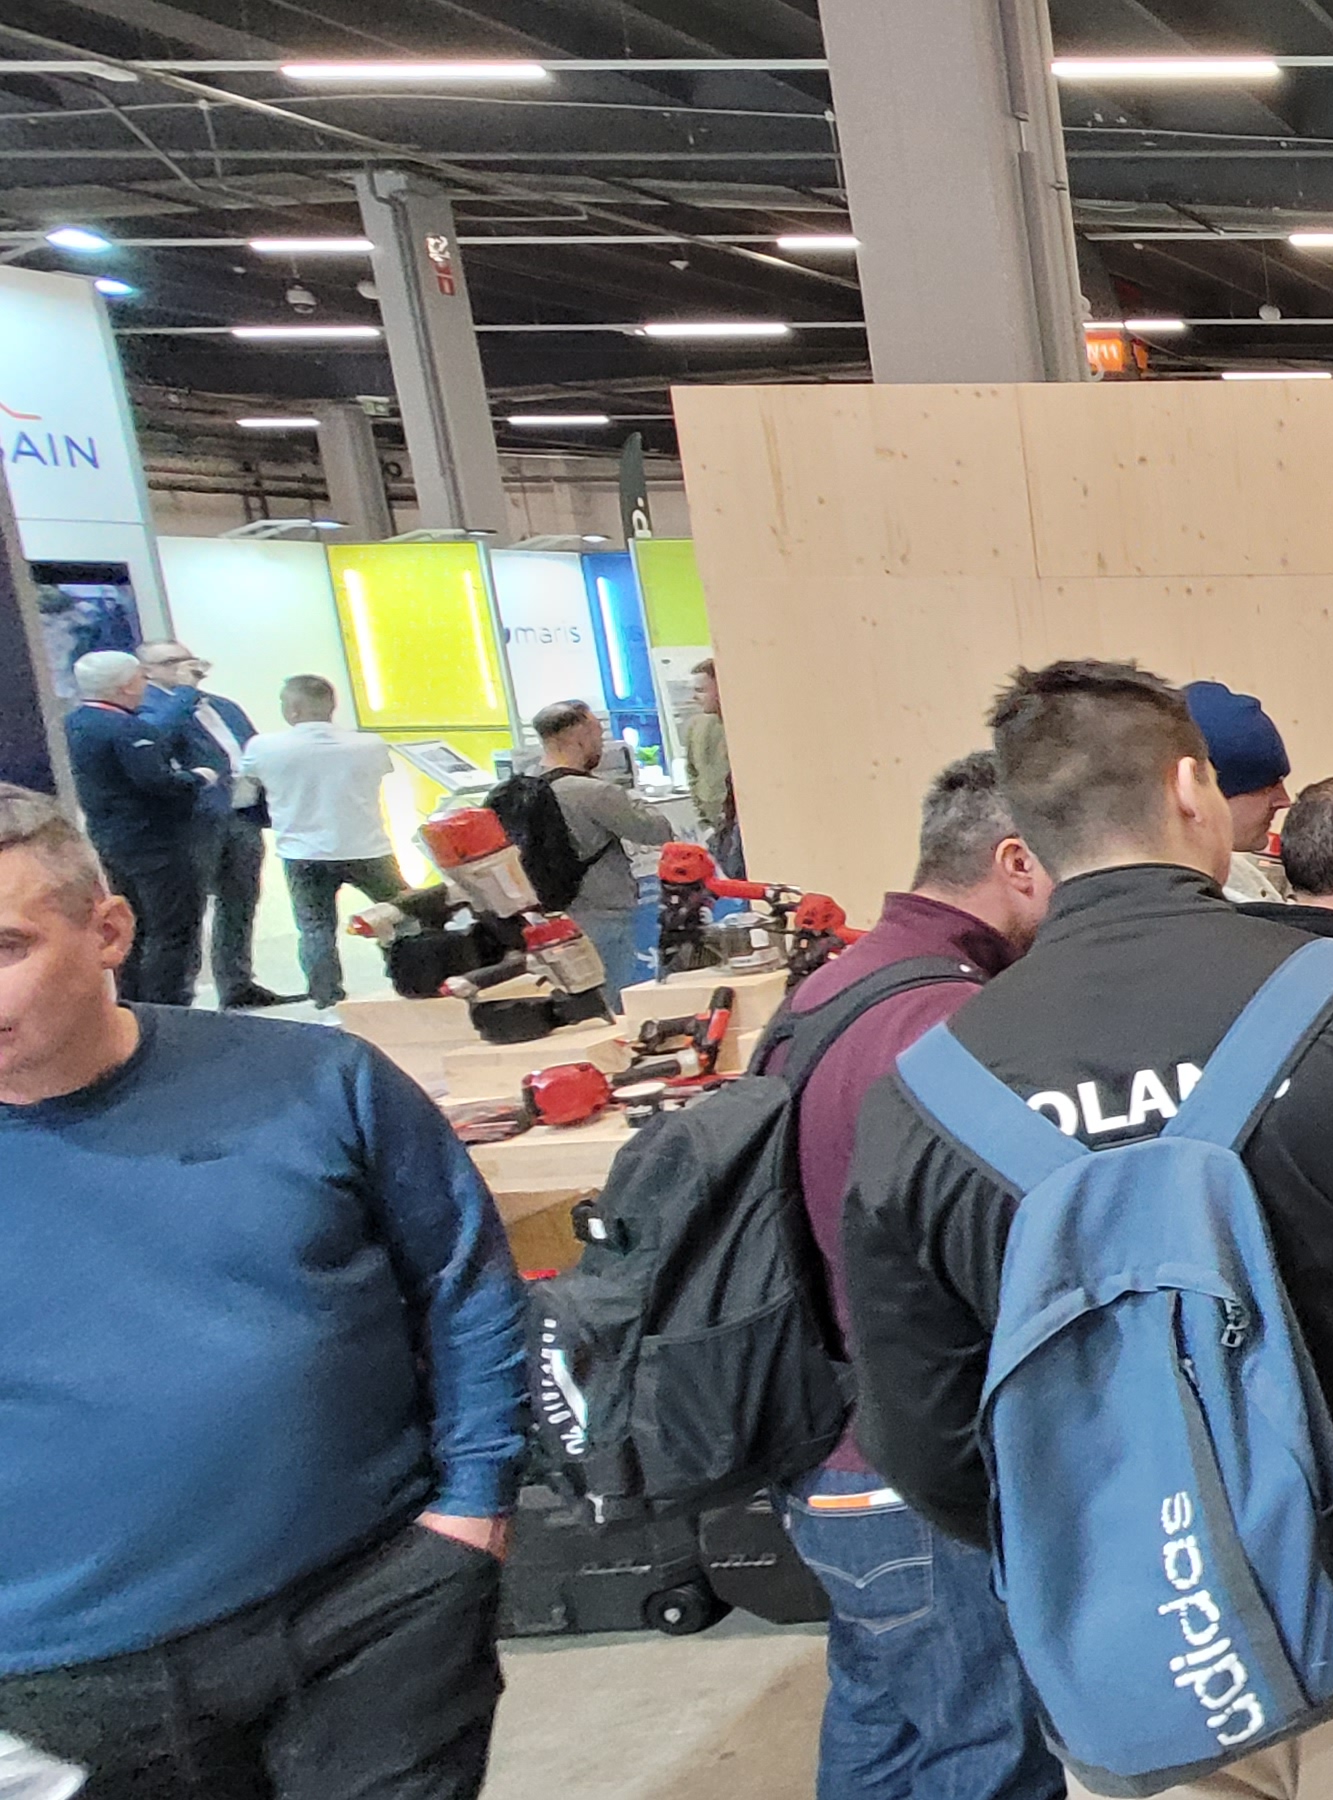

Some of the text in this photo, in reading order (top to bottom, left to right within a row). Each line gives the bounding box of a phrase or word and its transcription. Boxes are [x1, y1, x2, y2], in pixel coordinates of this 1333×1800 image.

[0, 431, 100, 469] AIN
[504, 624, 581, 645] maris
[1157, 1491, 1265, 1746] adidas
